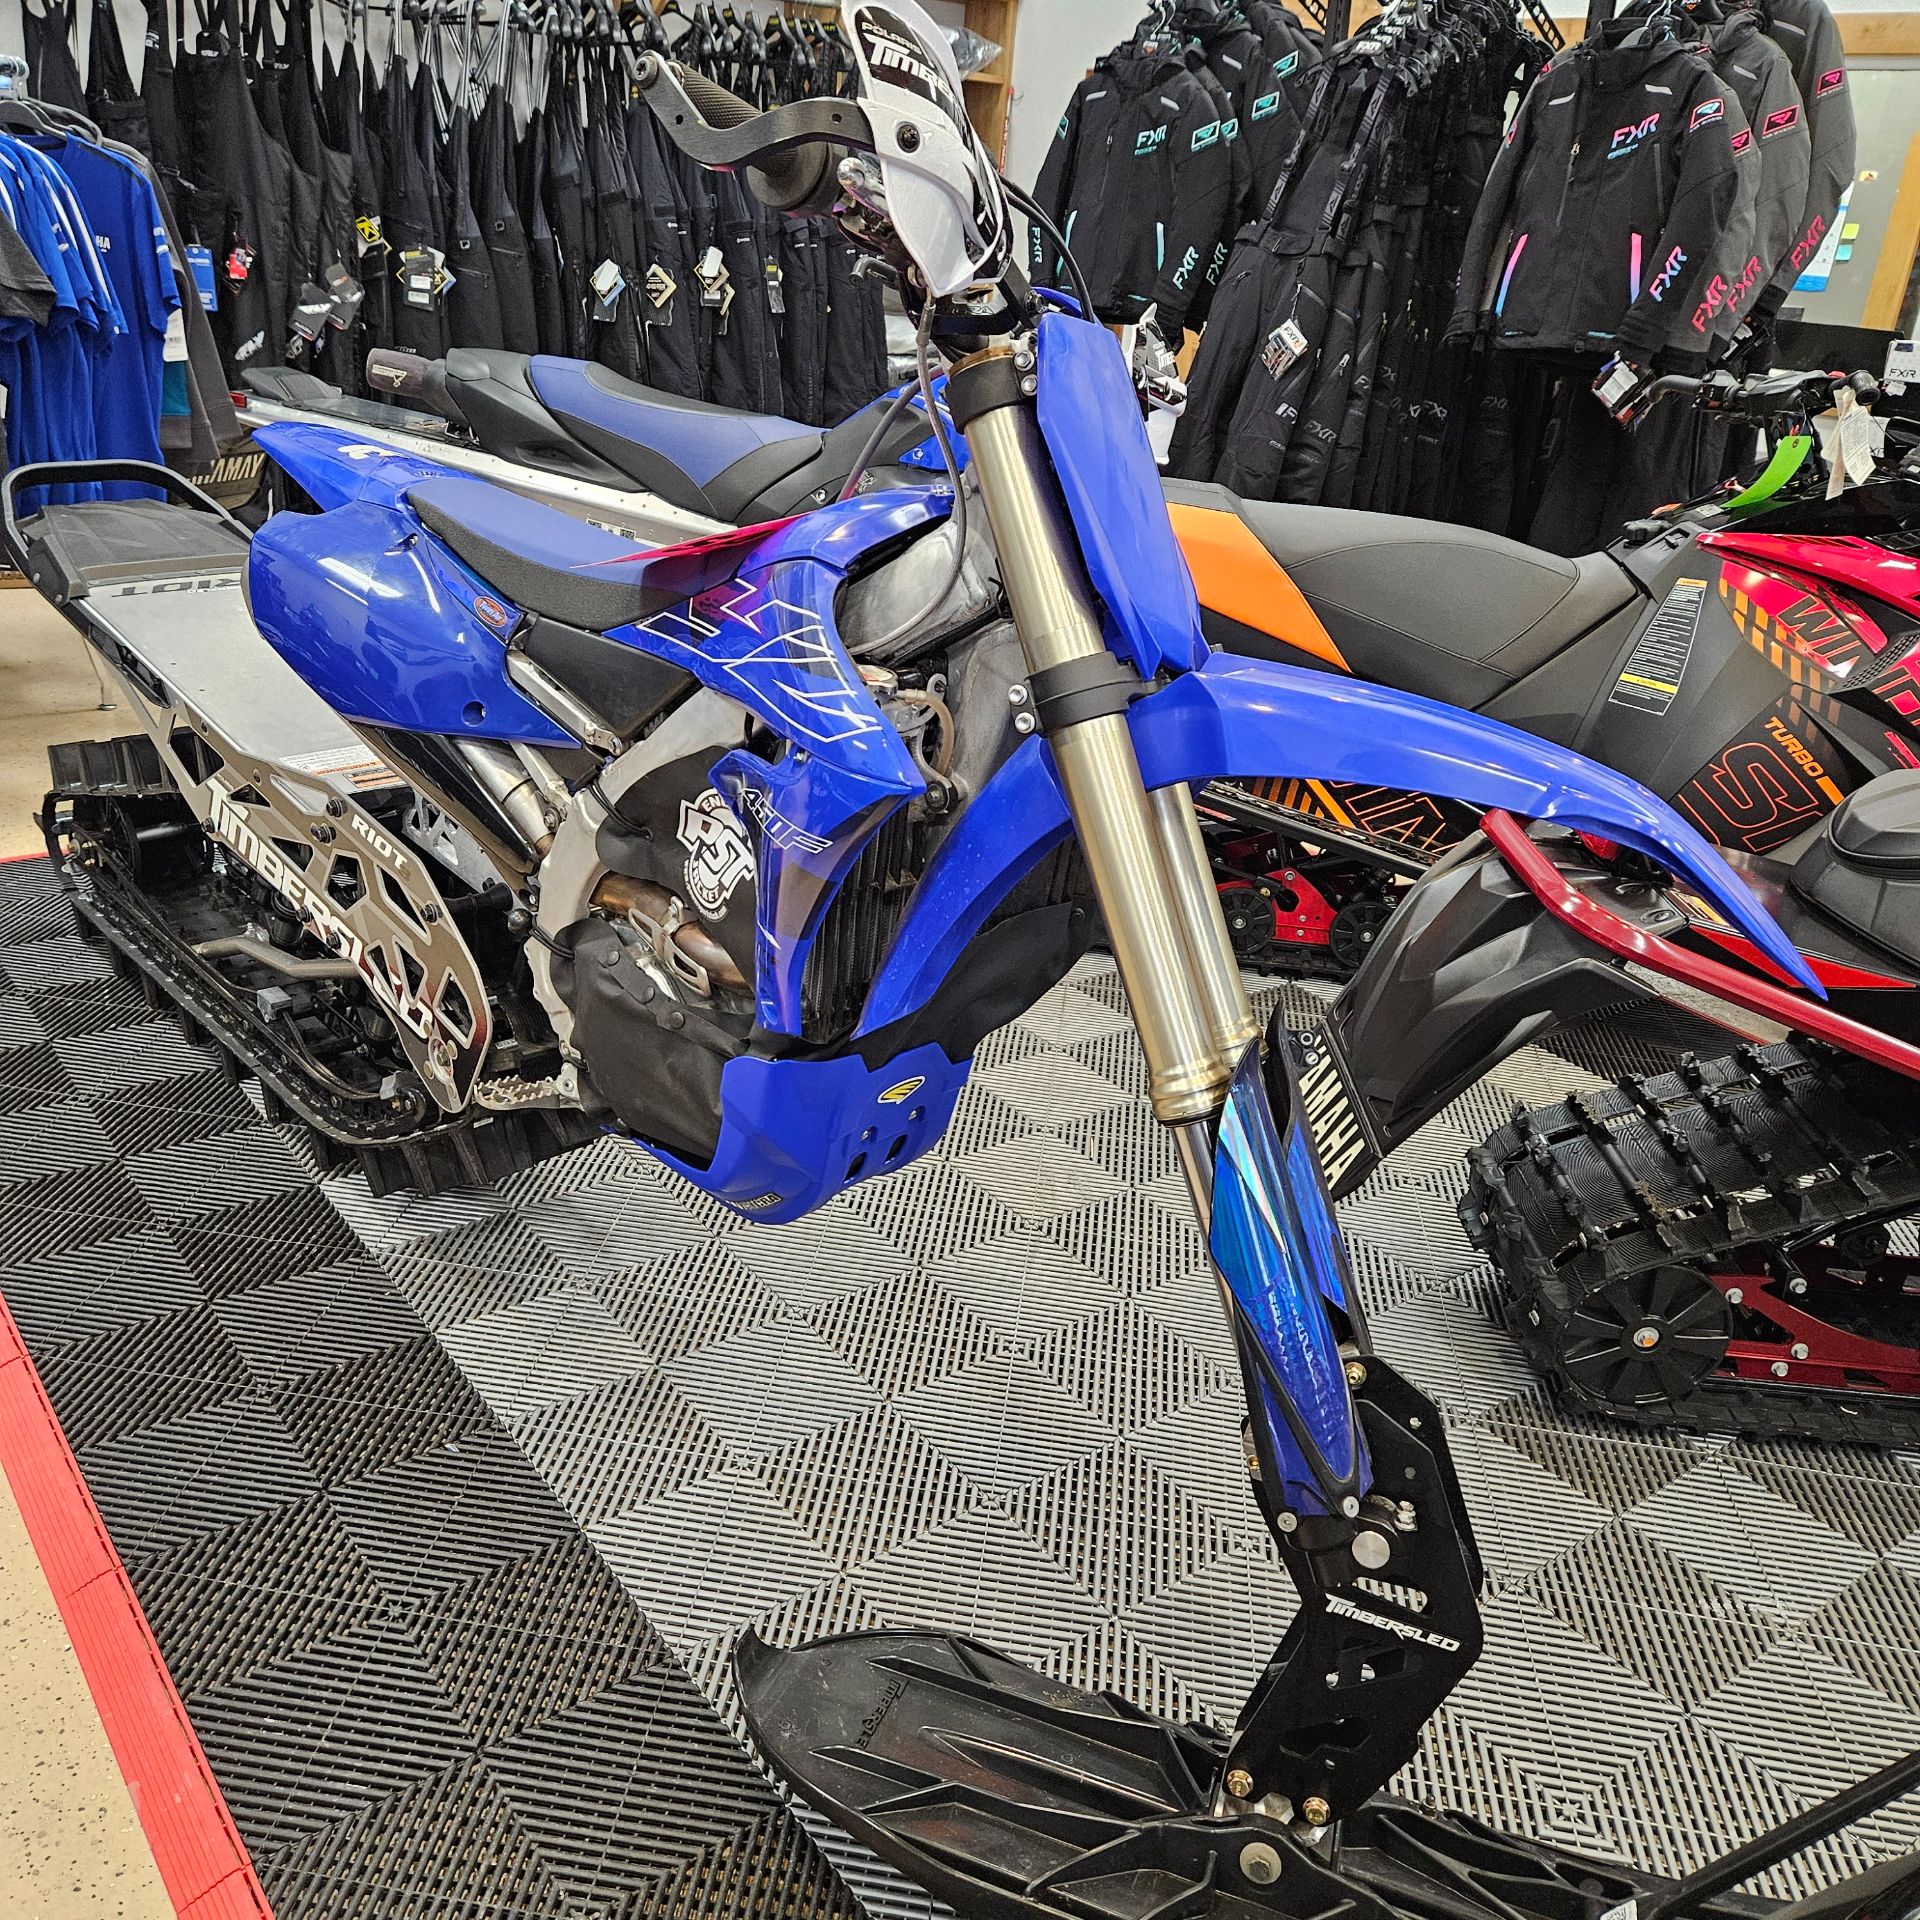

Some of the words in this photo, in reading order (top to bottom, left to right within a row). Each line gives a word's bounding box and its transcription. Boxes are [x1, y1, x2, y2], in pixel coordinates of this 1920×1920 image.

[861, 21, 922, 55] POLARIS
[1136, 124, 1168, 149] FXR
[1610, 112, 1661, 149] FXR
[1032, 227, 1044, 263] FXR
[1172, 245, 1200, 291] FXR
[1206, 242, 1229, 287] FXR
[1790, 215, 1826, 271] FXR
[1649, 245, 1688, 302] FXR
[1726, 255, 1763, 314] FXR
[1691, 274, 1728, 333] FXR
[1889, 368, 1917, 379] FXR
[1764, 716, 1824, 777] TURBO
[351, 813, 408, 870] RIOT
[1325, 1592, 1461, 1652] TIMBERSLED
